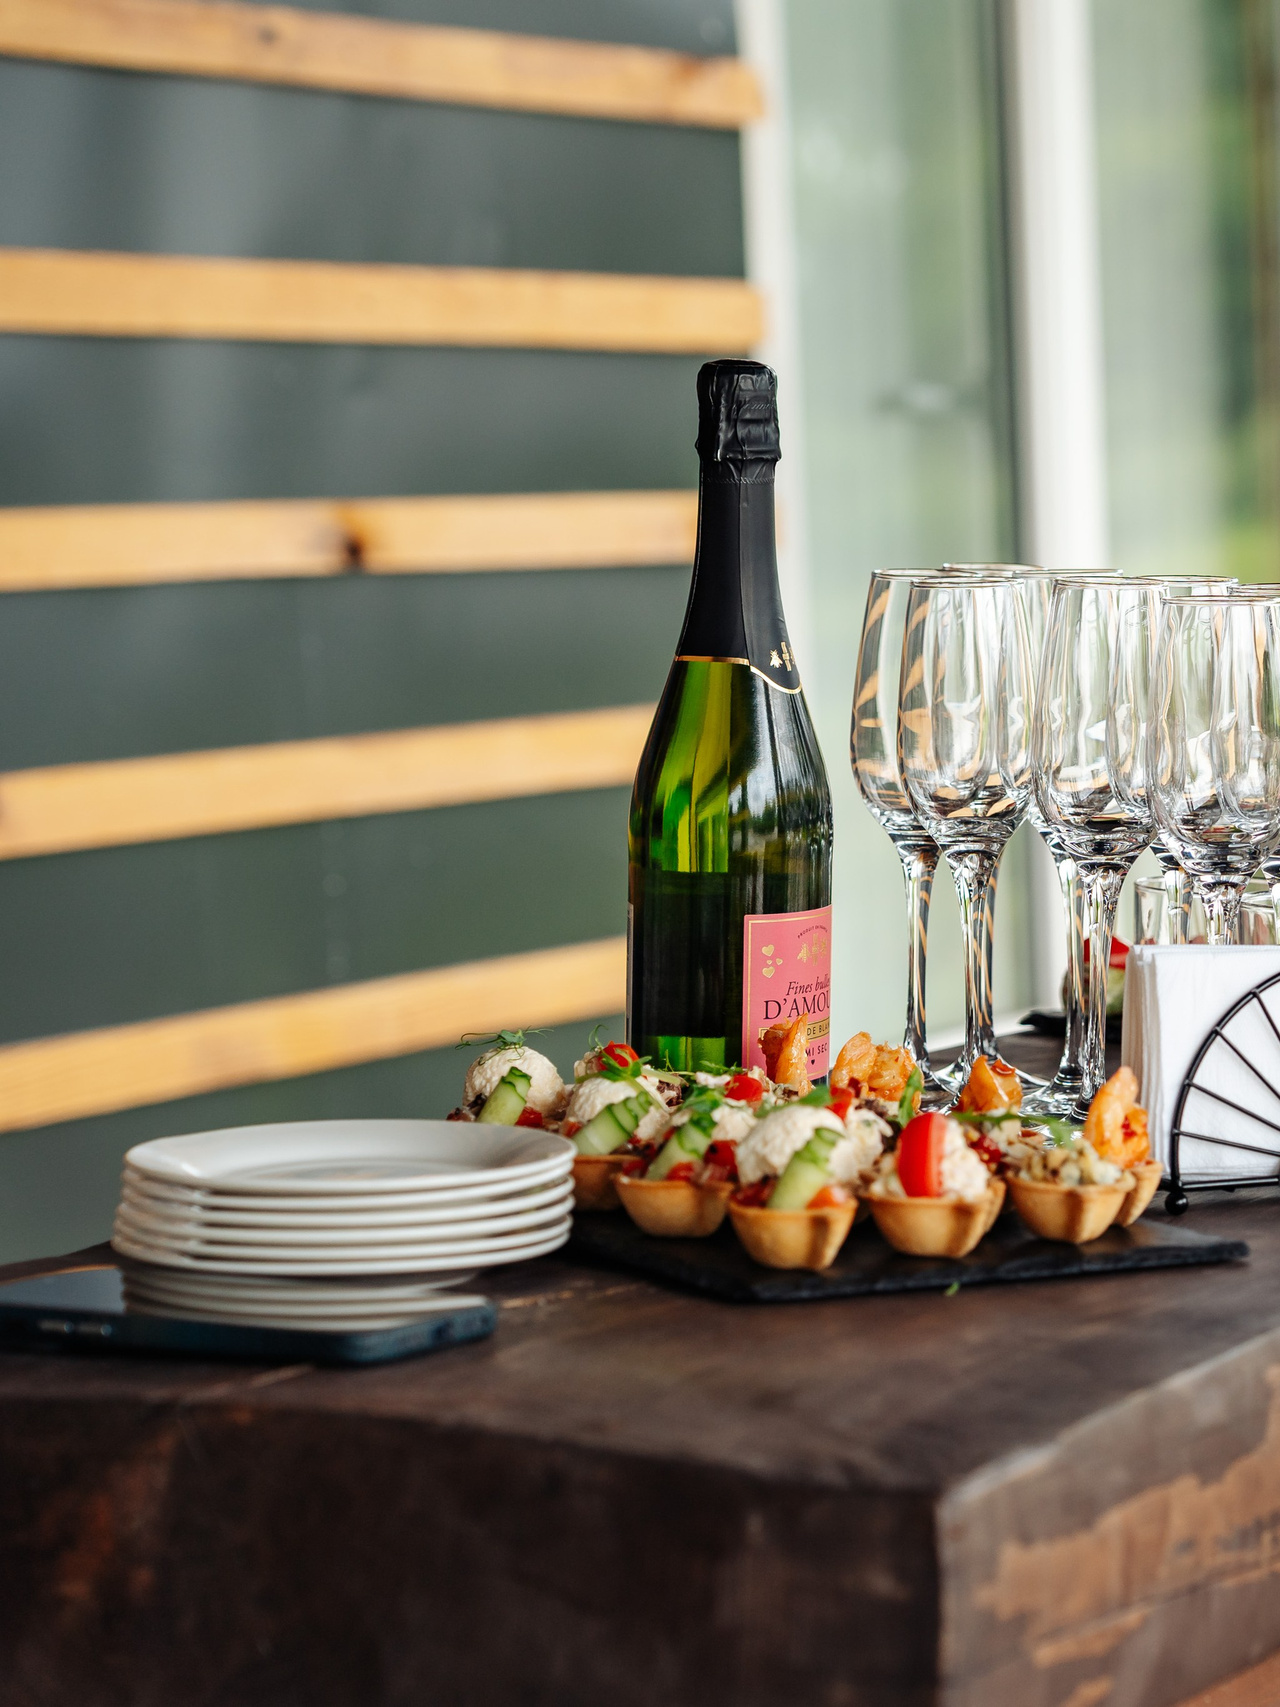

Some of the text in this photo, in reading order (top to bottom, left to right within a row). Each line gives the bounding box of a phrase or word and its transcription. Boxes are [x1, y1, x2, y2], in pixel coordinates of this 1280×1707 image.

[786, 981, 813, 996] Fines
[807, 1026, 816, 1036] DE
[817, 1042, 828, 1055] SEC
